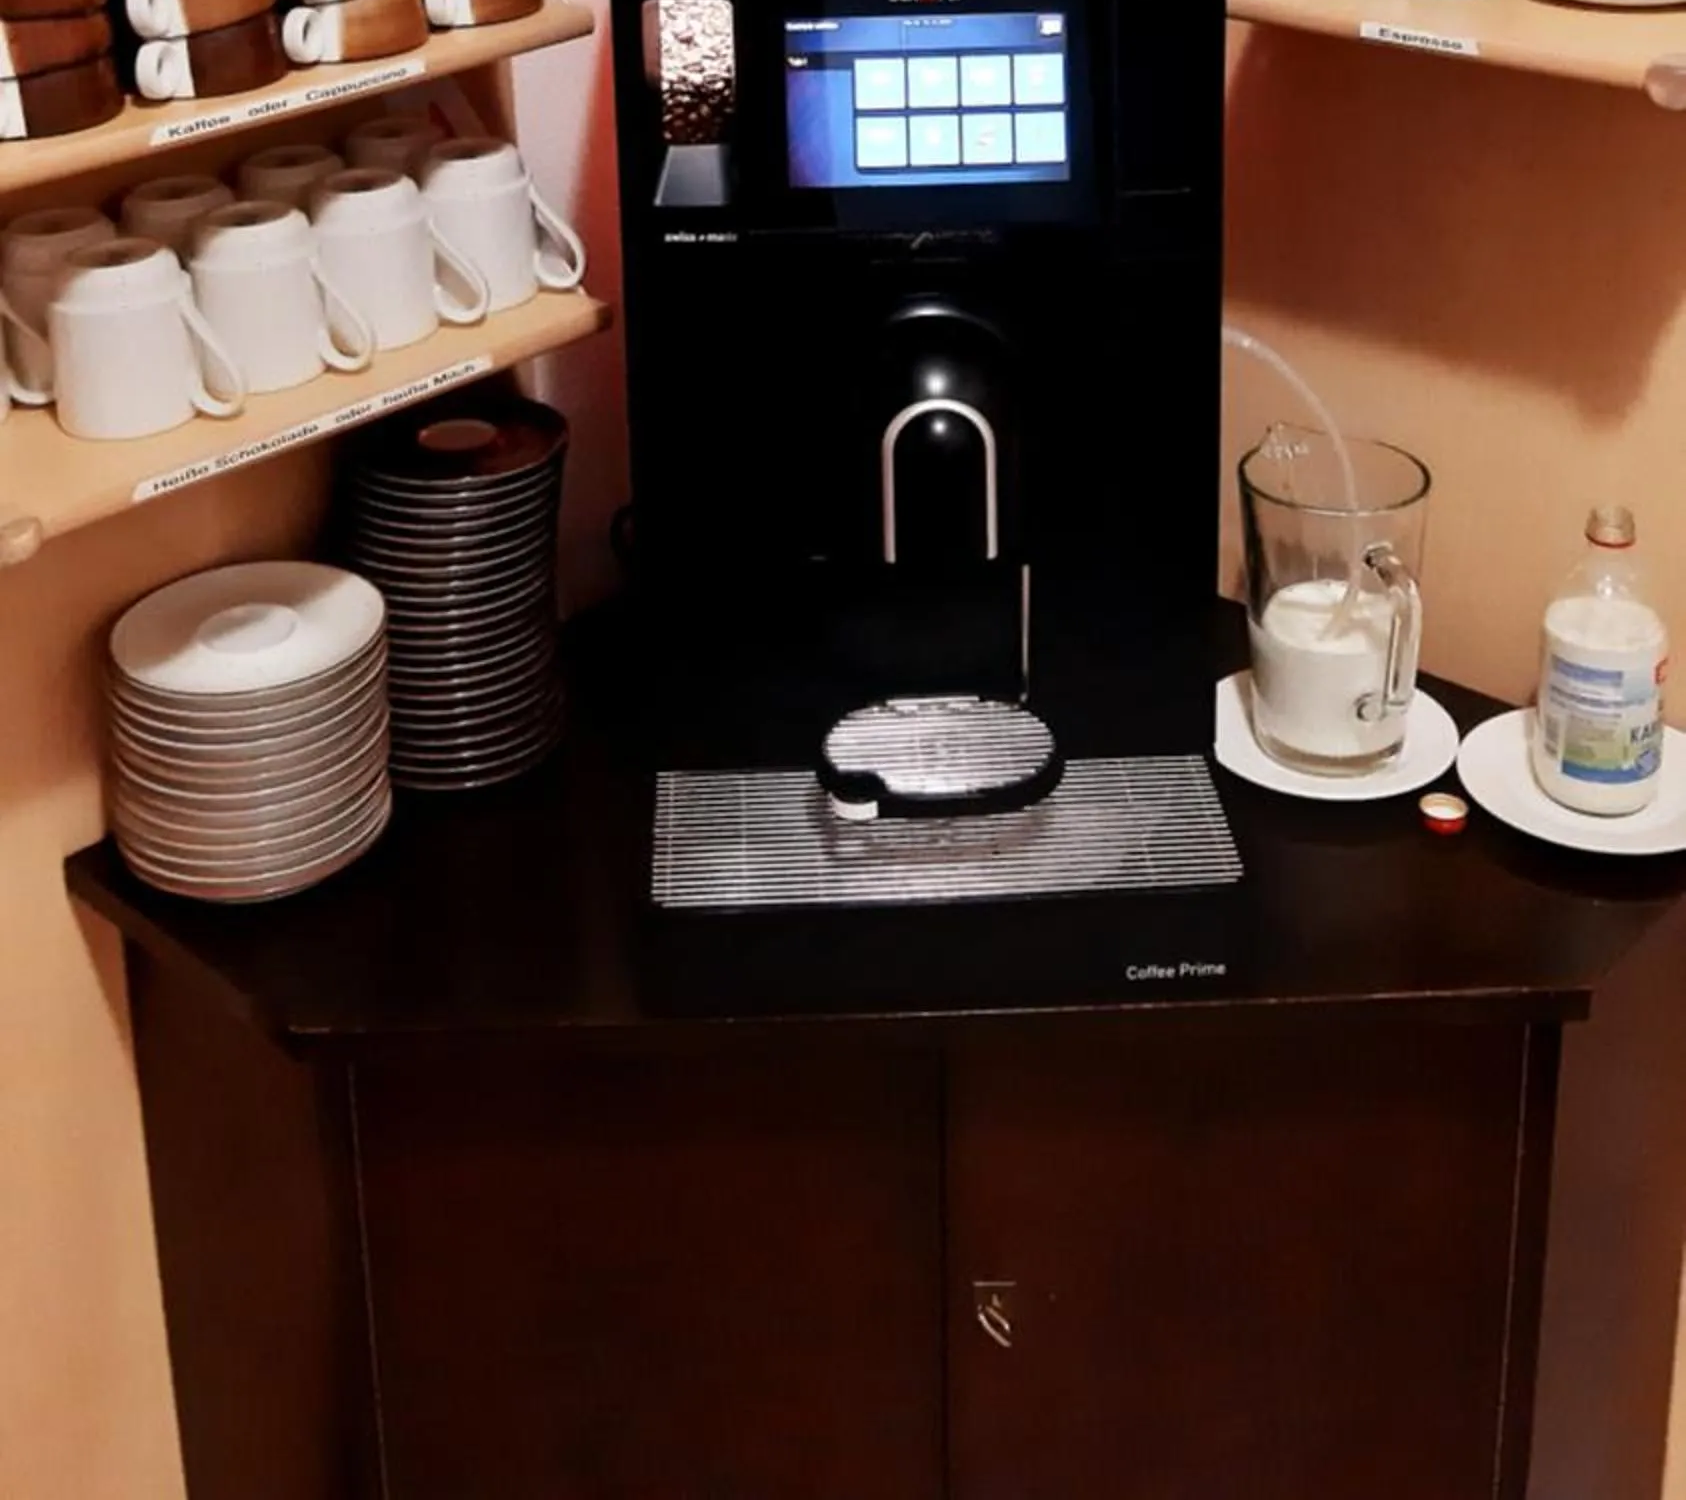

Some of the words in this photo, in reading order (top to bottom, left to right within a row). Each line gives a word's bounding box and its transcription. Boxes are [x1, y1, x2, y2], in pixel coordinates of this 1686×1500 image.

[1379, 27, 1463, 49] Espresso
[168, 115, 231, 137] Kaffee
[248, 99, 287, 117] oder
[305, 67, 407, 101] Cappuccino
[153, 464, 209, 492] Heiße
[214, 423, 319, 469] Schokolade
[334, 403, 373, 424] oder
[433, 364, 476, 387] Milch
[1126, 964, 1176, 980] Coffee
[1179, 961, 1227, 977] Prime
